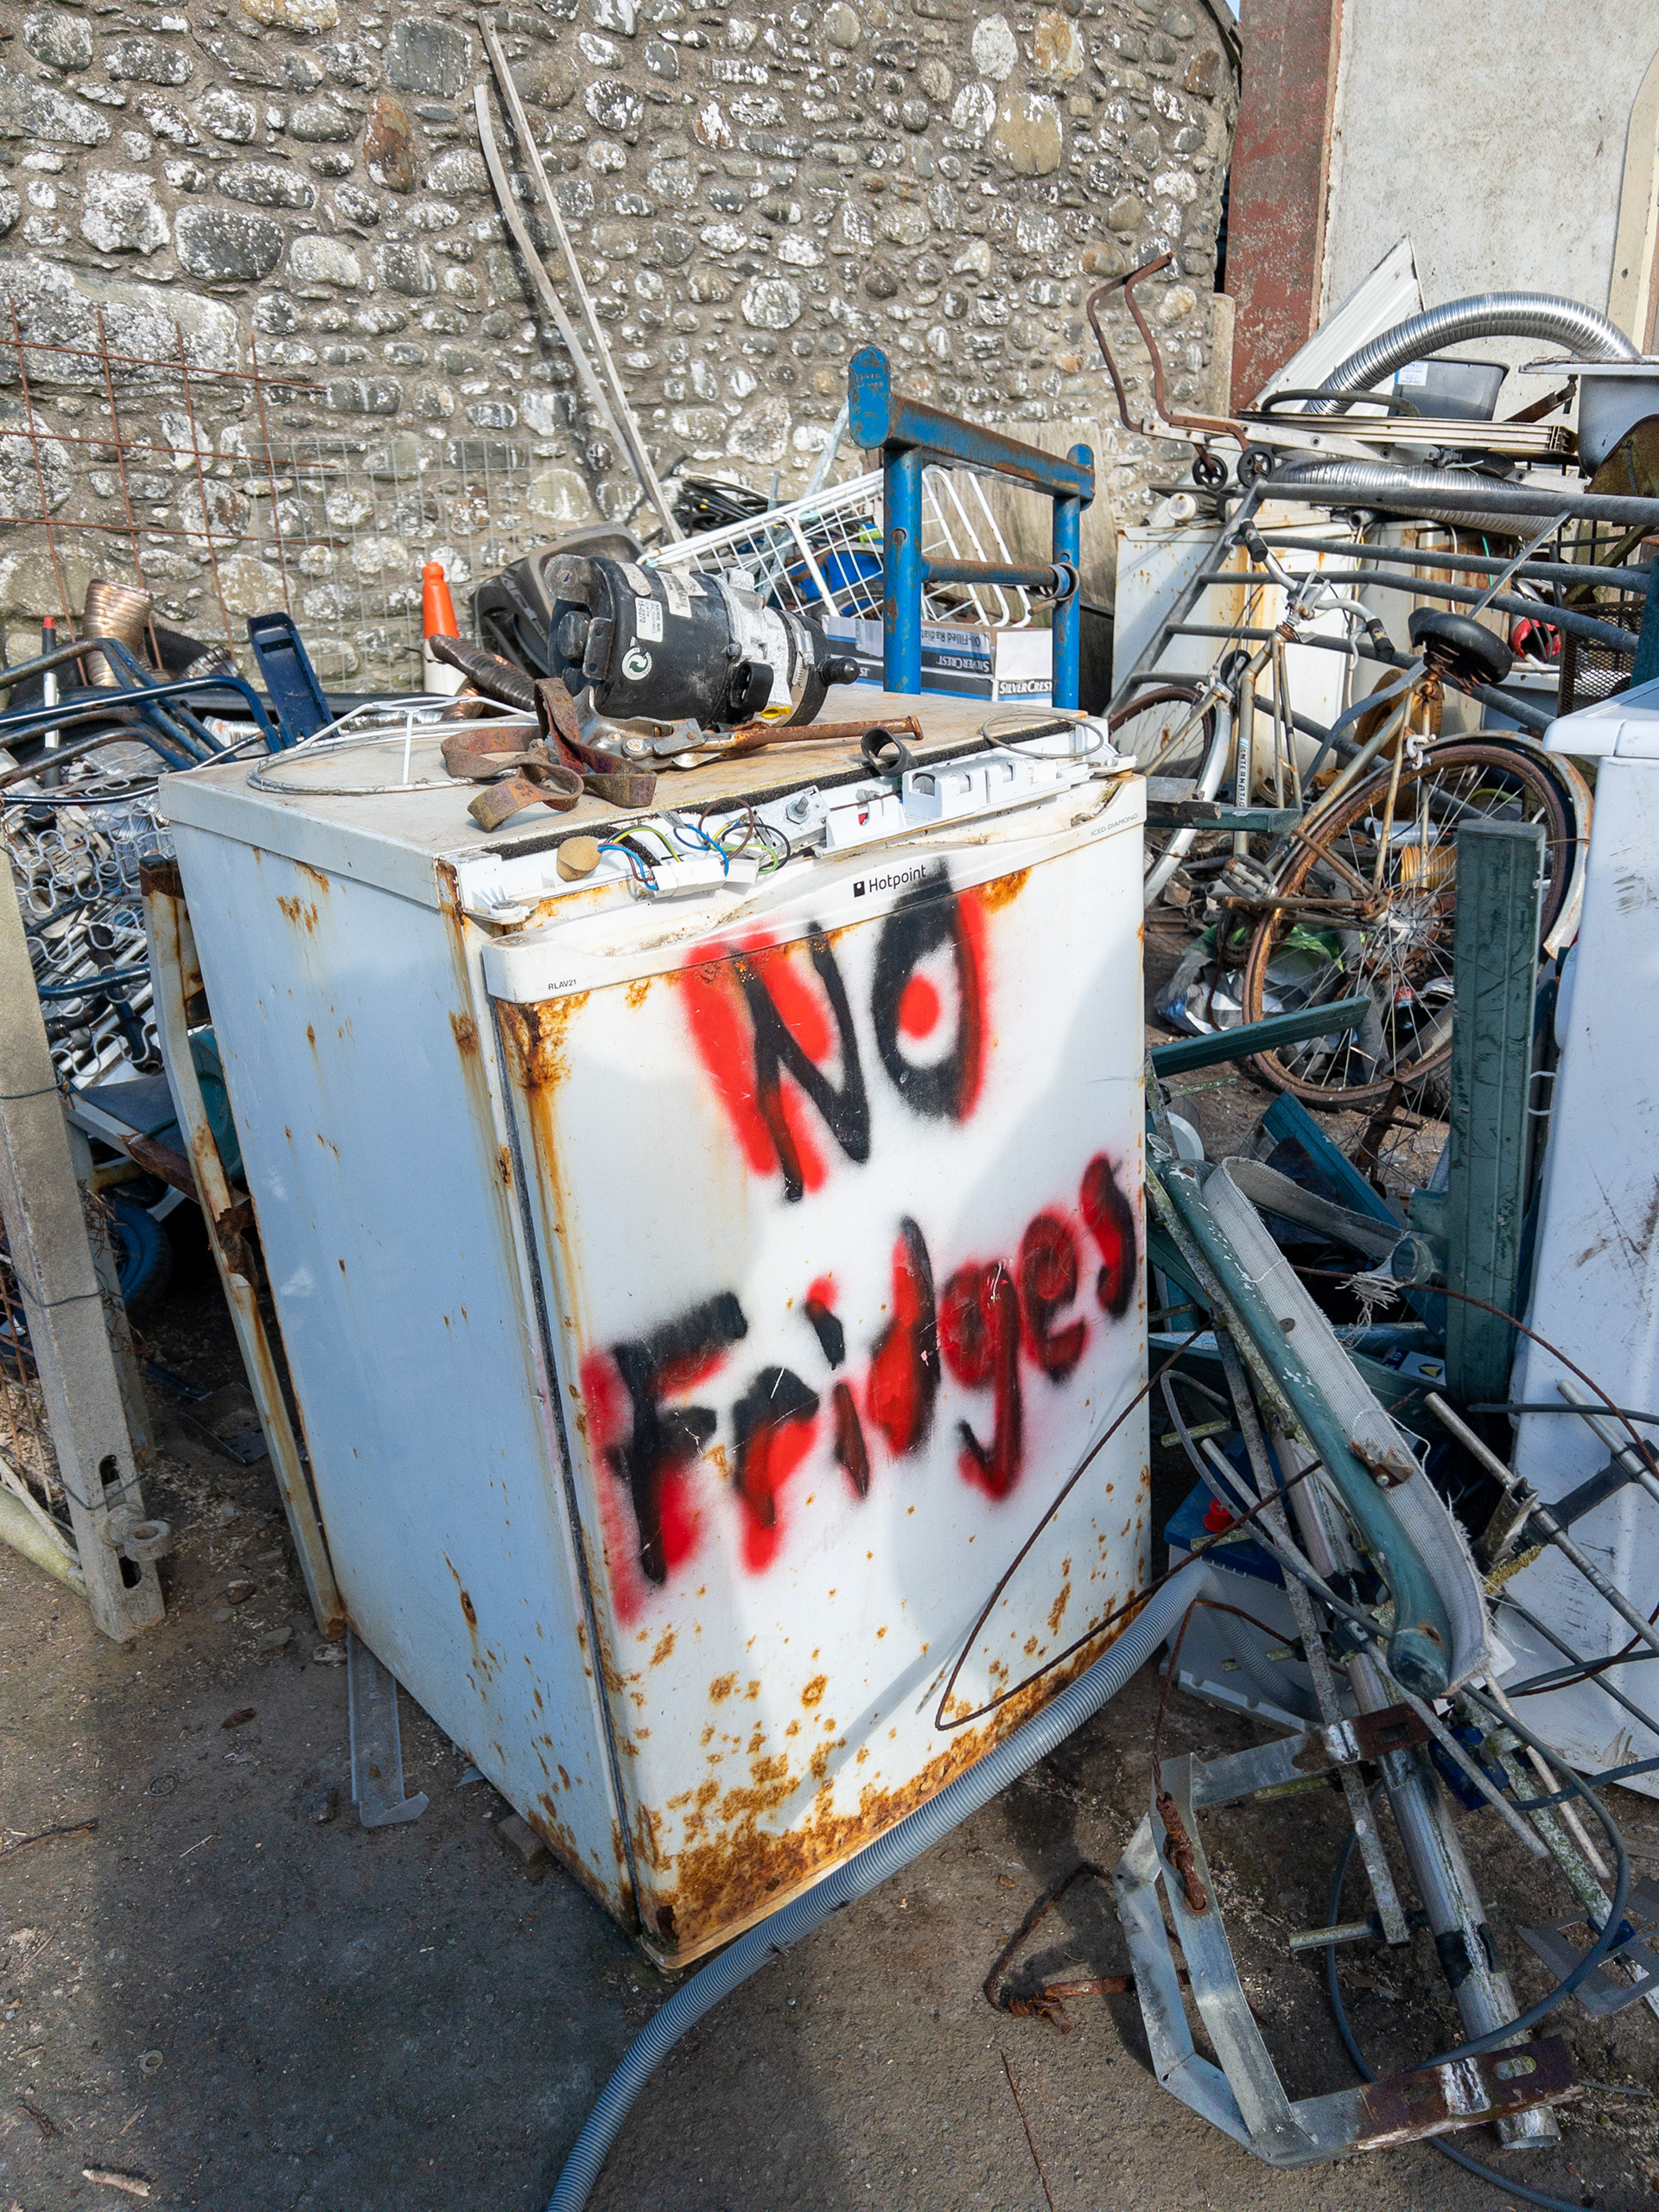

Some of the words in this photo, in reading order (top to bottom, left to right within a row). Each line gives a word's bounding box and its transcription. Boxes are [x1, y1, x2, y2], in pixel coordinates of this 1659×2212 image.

[947, 631, 982, 647] Oil-Filled
[1090, 826, 1107, 837] ICED
[1107, 813, 1139, 830] DIAMOND
[868, 864, 927, 893] Hotpoint
[548, 978, 577, 991] RLAV21
[579, 1154, 1137, 1624] Fridges
